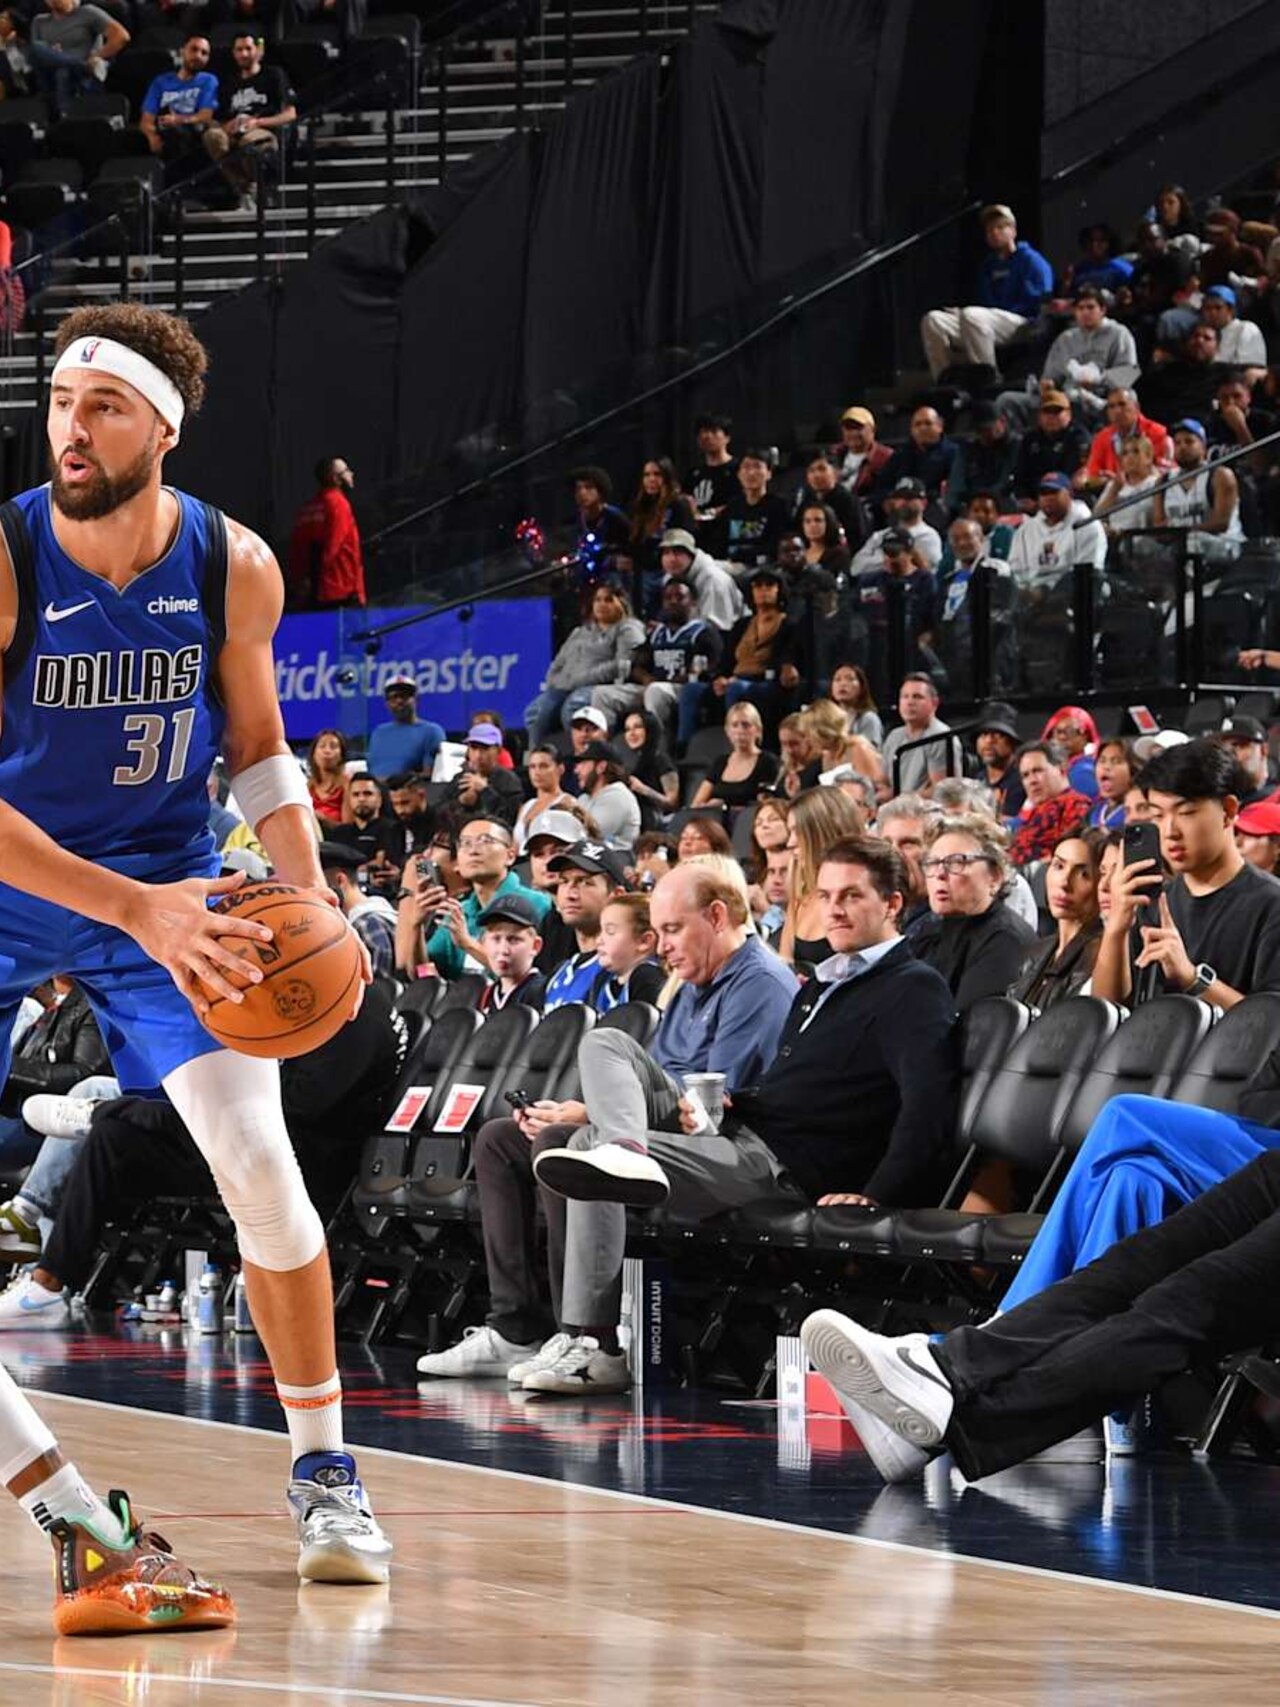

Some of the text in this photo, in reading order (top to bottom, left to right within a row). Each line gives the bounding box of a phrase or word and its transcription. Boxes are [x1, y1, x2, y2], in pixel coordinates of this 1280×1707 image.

[147, 596, 199, 615] chime
[32, 644, 202, 709] DALLAS
[276, 648, 519, 700] ticketmaster
[113, 707, 196, 785] 31
